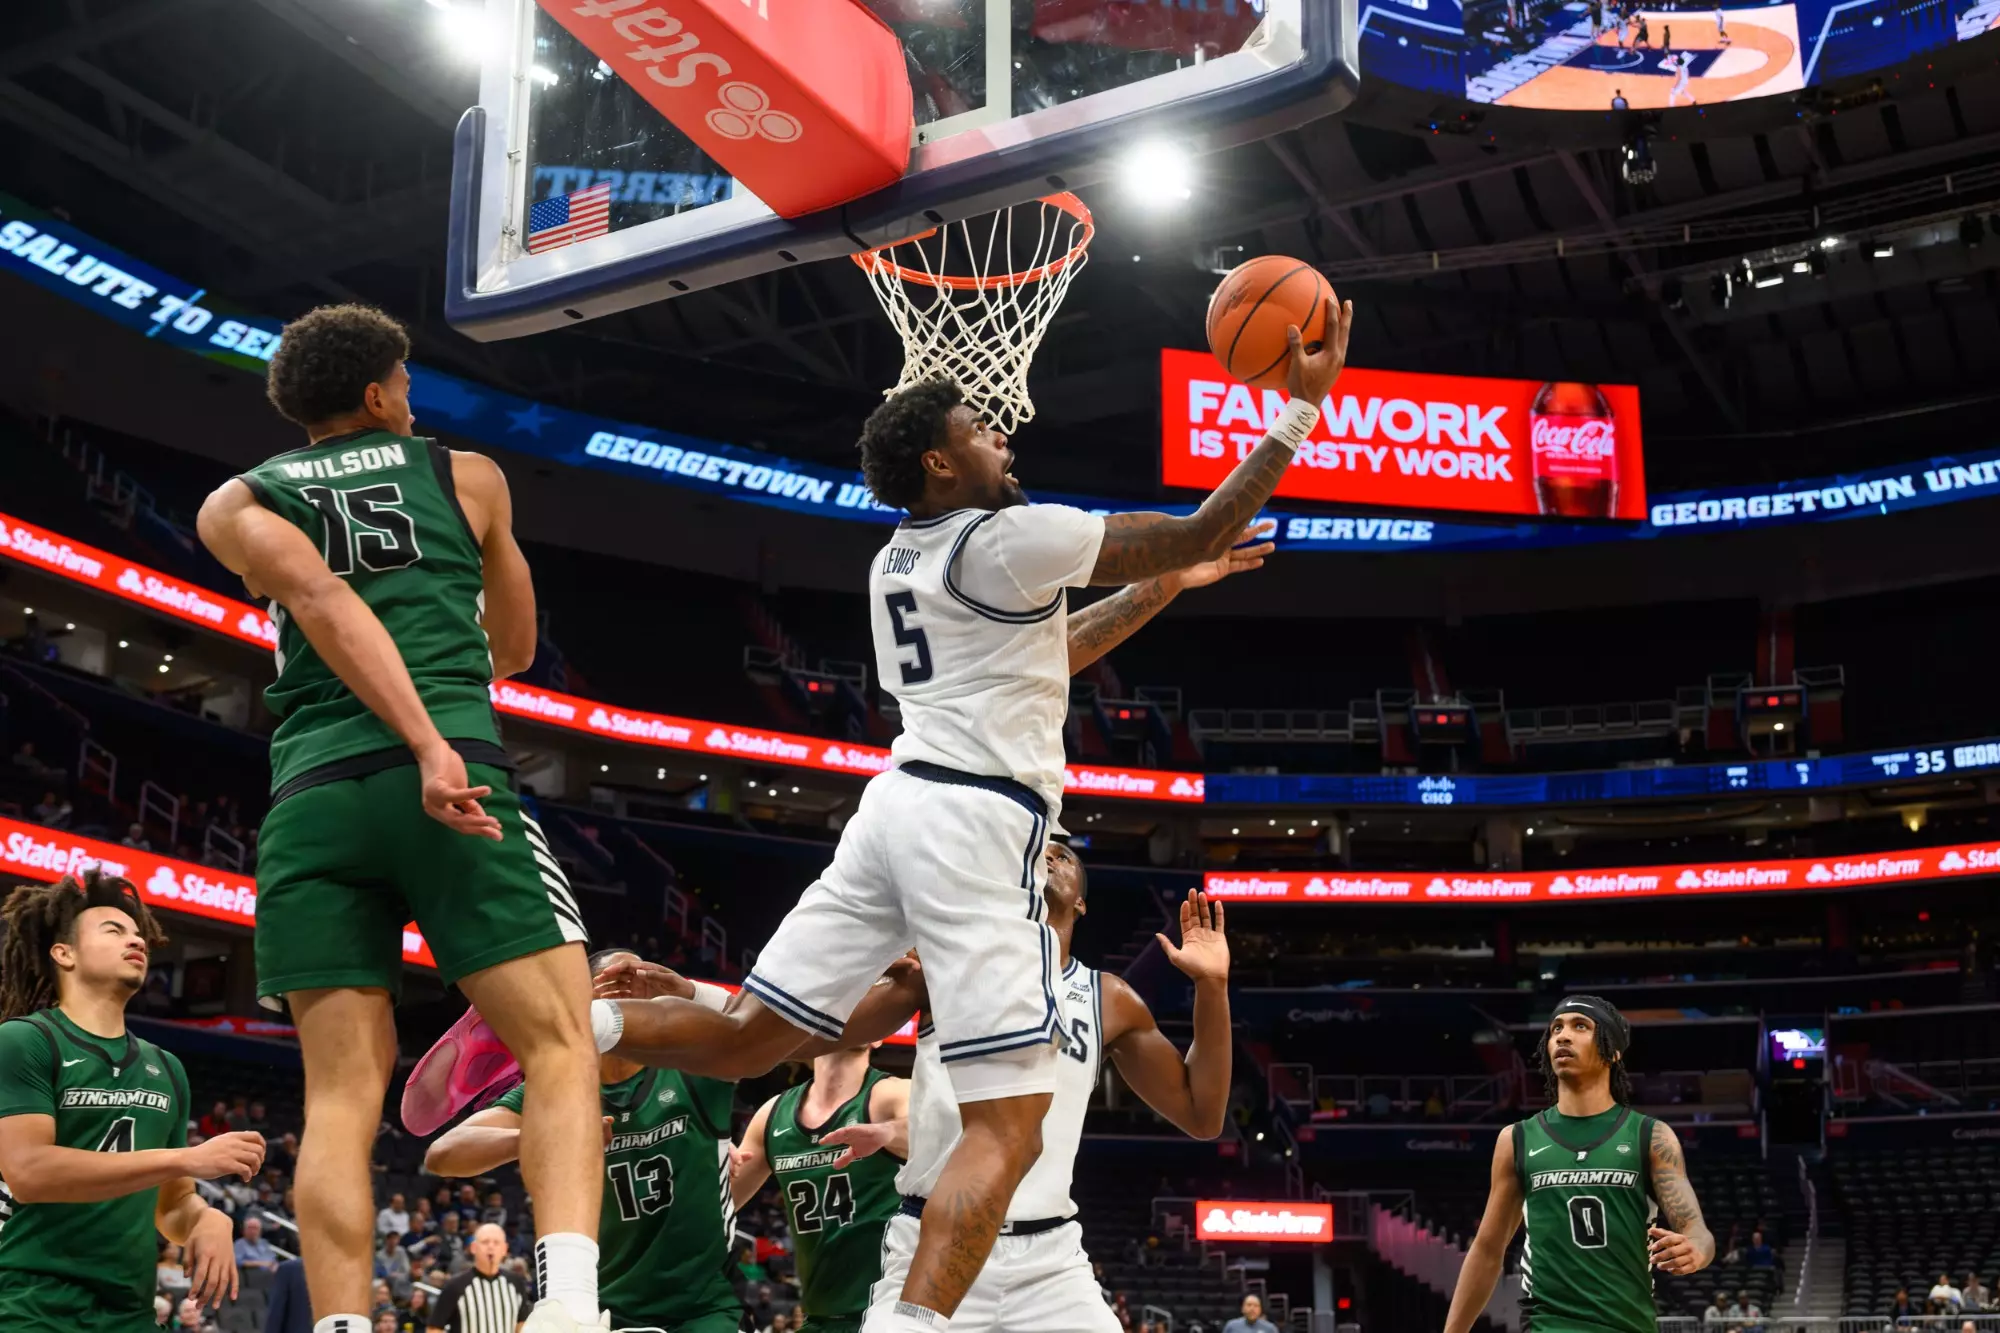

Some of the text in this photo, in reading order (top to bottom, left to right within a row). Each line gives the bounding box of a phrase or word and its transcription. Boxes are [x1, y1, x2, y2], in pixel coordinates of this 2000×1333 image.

[0, 220, 158, 309] SALUTE
[150, 295, 213, 334] TO
[1320, 394, 1512, 452] WORK
[1532, 418, 1614, 455] Coca-Cola
[282, 443, 406, 478] WILSON
[585, 431, 833, 503] GEORGETOWN
[1189, 428, 1225, 459] IS
[1393, 446, 1514, 482] WORK
[1651, 475, 1916, 527] GEORGETOWN
[298, 483, 423, 575] 15
[1286, 517, 1434, 541] SERVICE
[882, 547, 921, 575] LEWIS
[885, 588, 934, 687] 5
[1914, 749, 1947, 775] 35
[1953, 743, 2000, 768] GEOR
[63, 1090, 169, 1109] BINGHAMTON
[95, 1116, 136, 1152] 4
[607, 1154, 674, 1221] 13
[787, 1172, 856, 1234] 24
[1532, 1171, 1636, 1188] BINGHAMTON
[1566, 1195, 1607, 1249] 0
